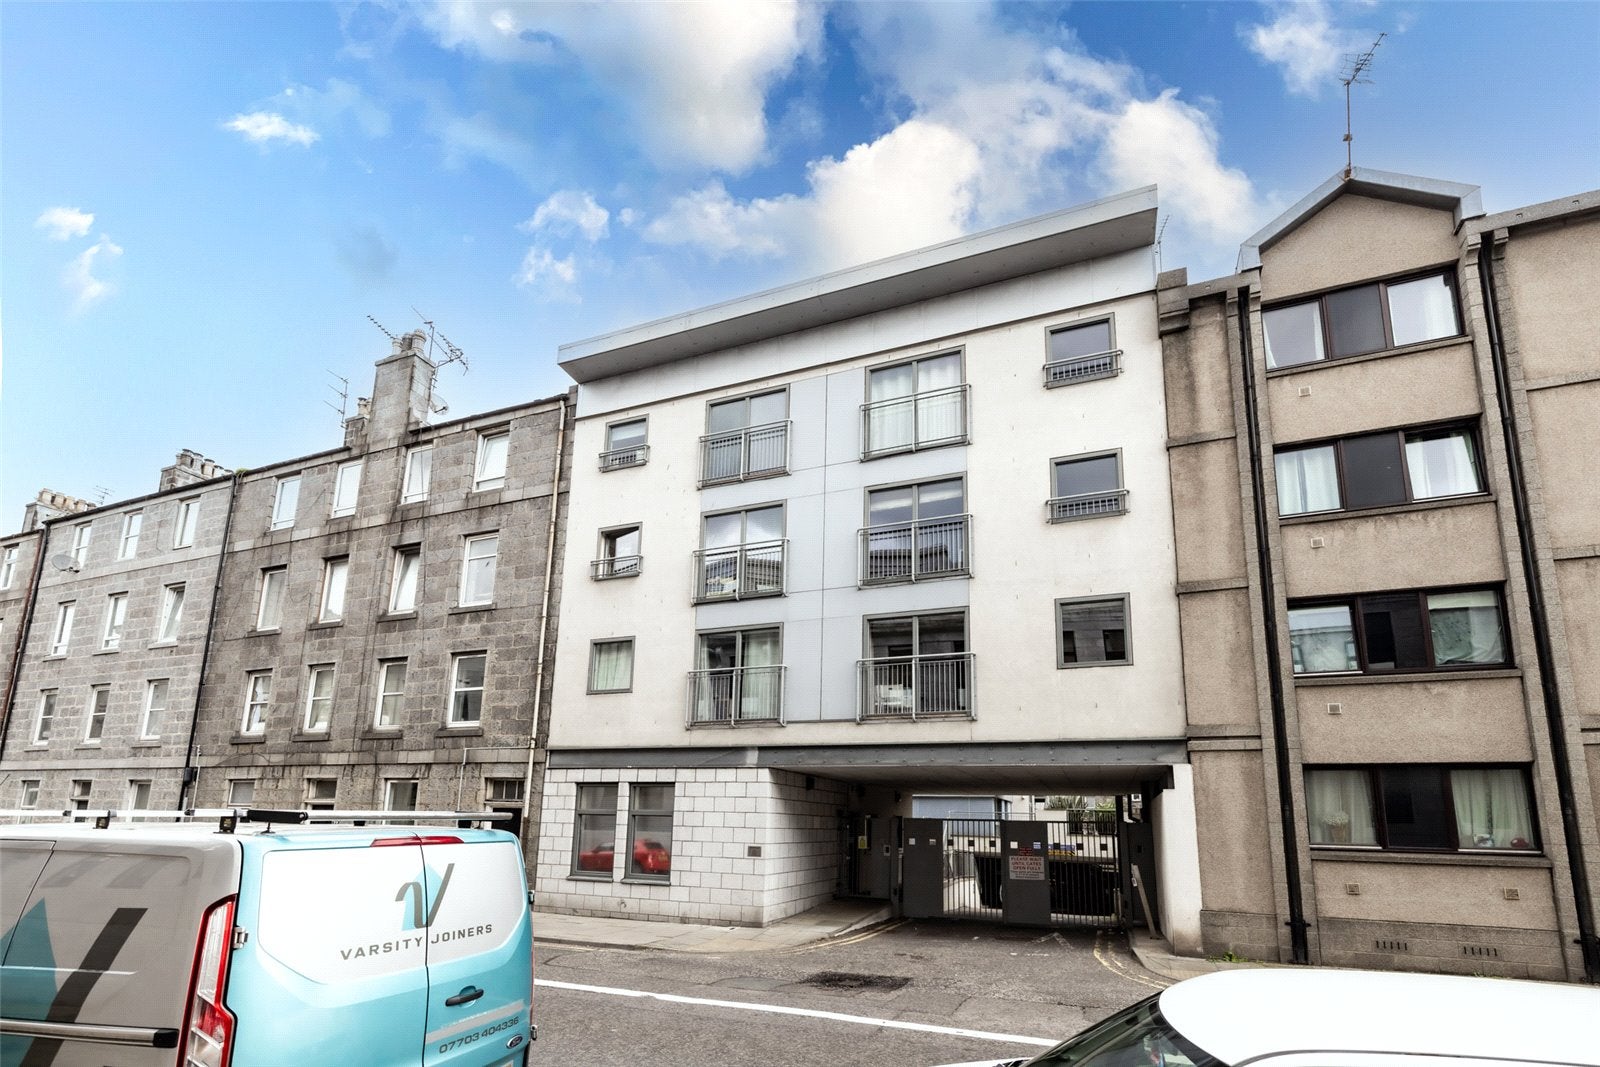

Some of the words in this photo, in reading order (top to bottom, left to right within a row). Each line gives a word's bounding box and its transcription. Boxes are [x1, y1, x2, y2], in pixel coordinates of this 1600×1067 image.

[340, 936, 423, 961] VARSITY
[431, 923, 493, 945] JOINERS
[439, 1032, 480, 1054] 07703
[481, 1016, 520, 1038] 404336
